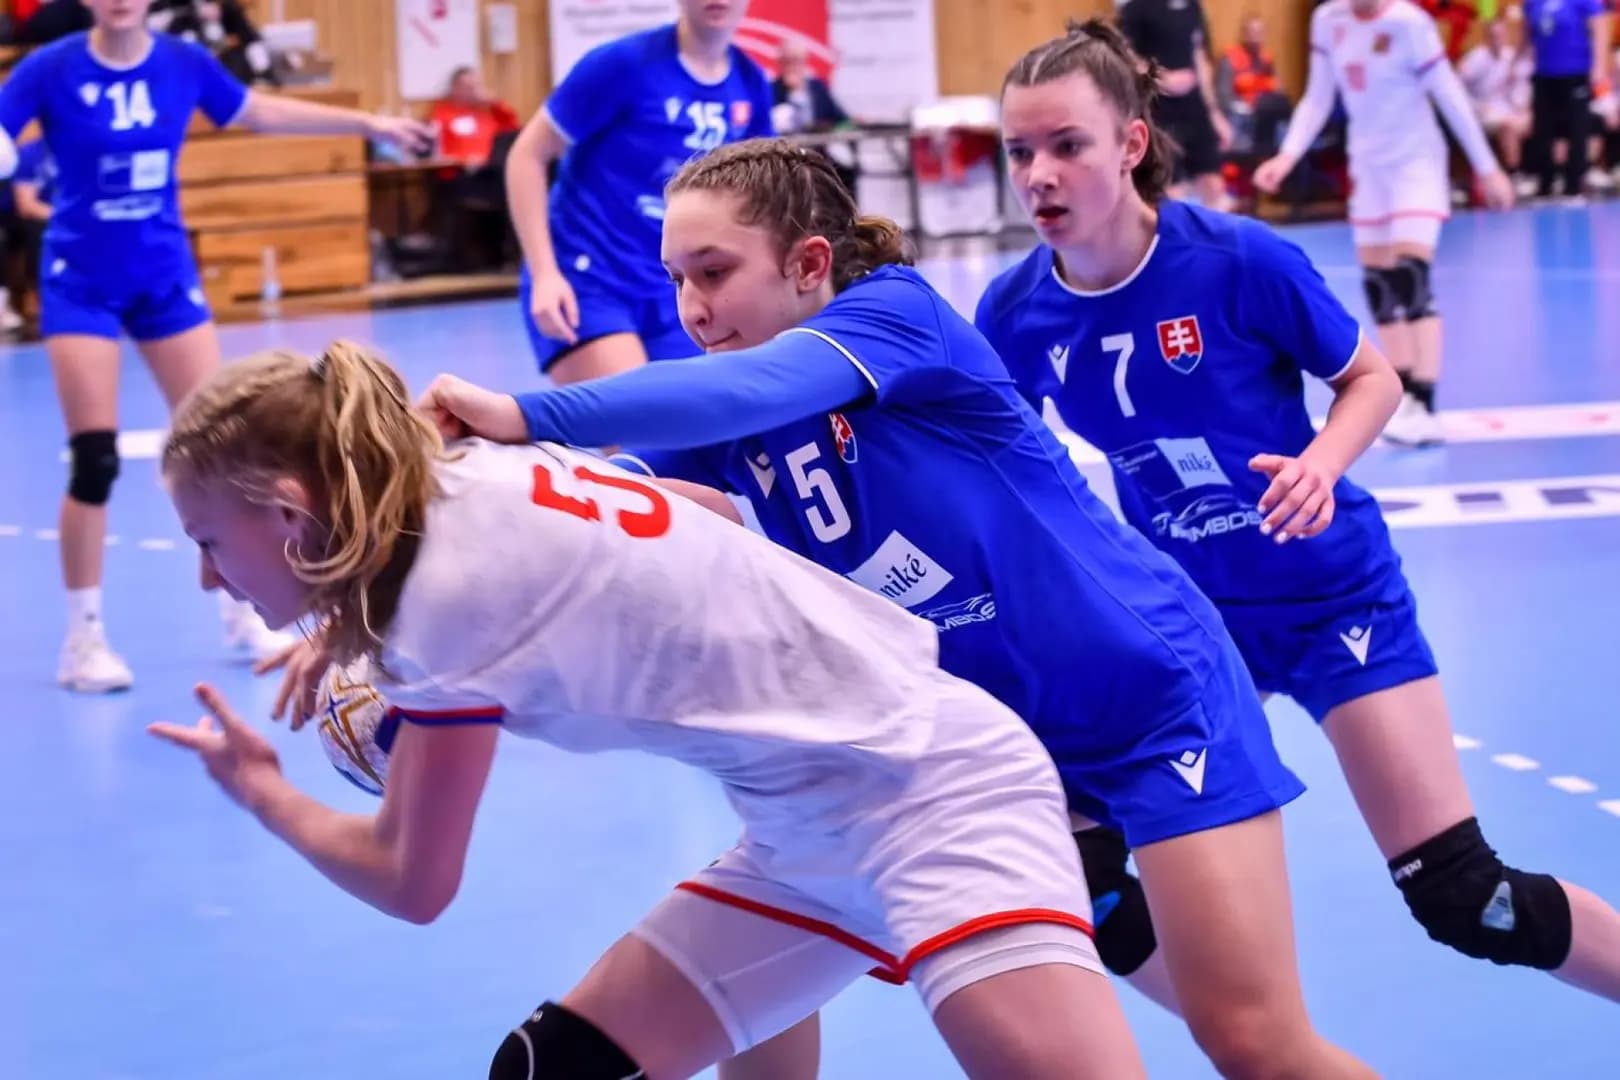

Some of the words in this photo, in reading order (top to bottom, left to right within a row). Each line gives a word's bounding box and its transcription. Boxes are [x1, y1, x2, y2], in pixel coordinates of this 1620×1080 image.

[104, 80, 157, 131] 14
[683, 100, 728, 151] 15
[1101, 332, 1136, 418] 7
[785, 441, 851, 543] 5
[880, 553, 927, 598] niké
